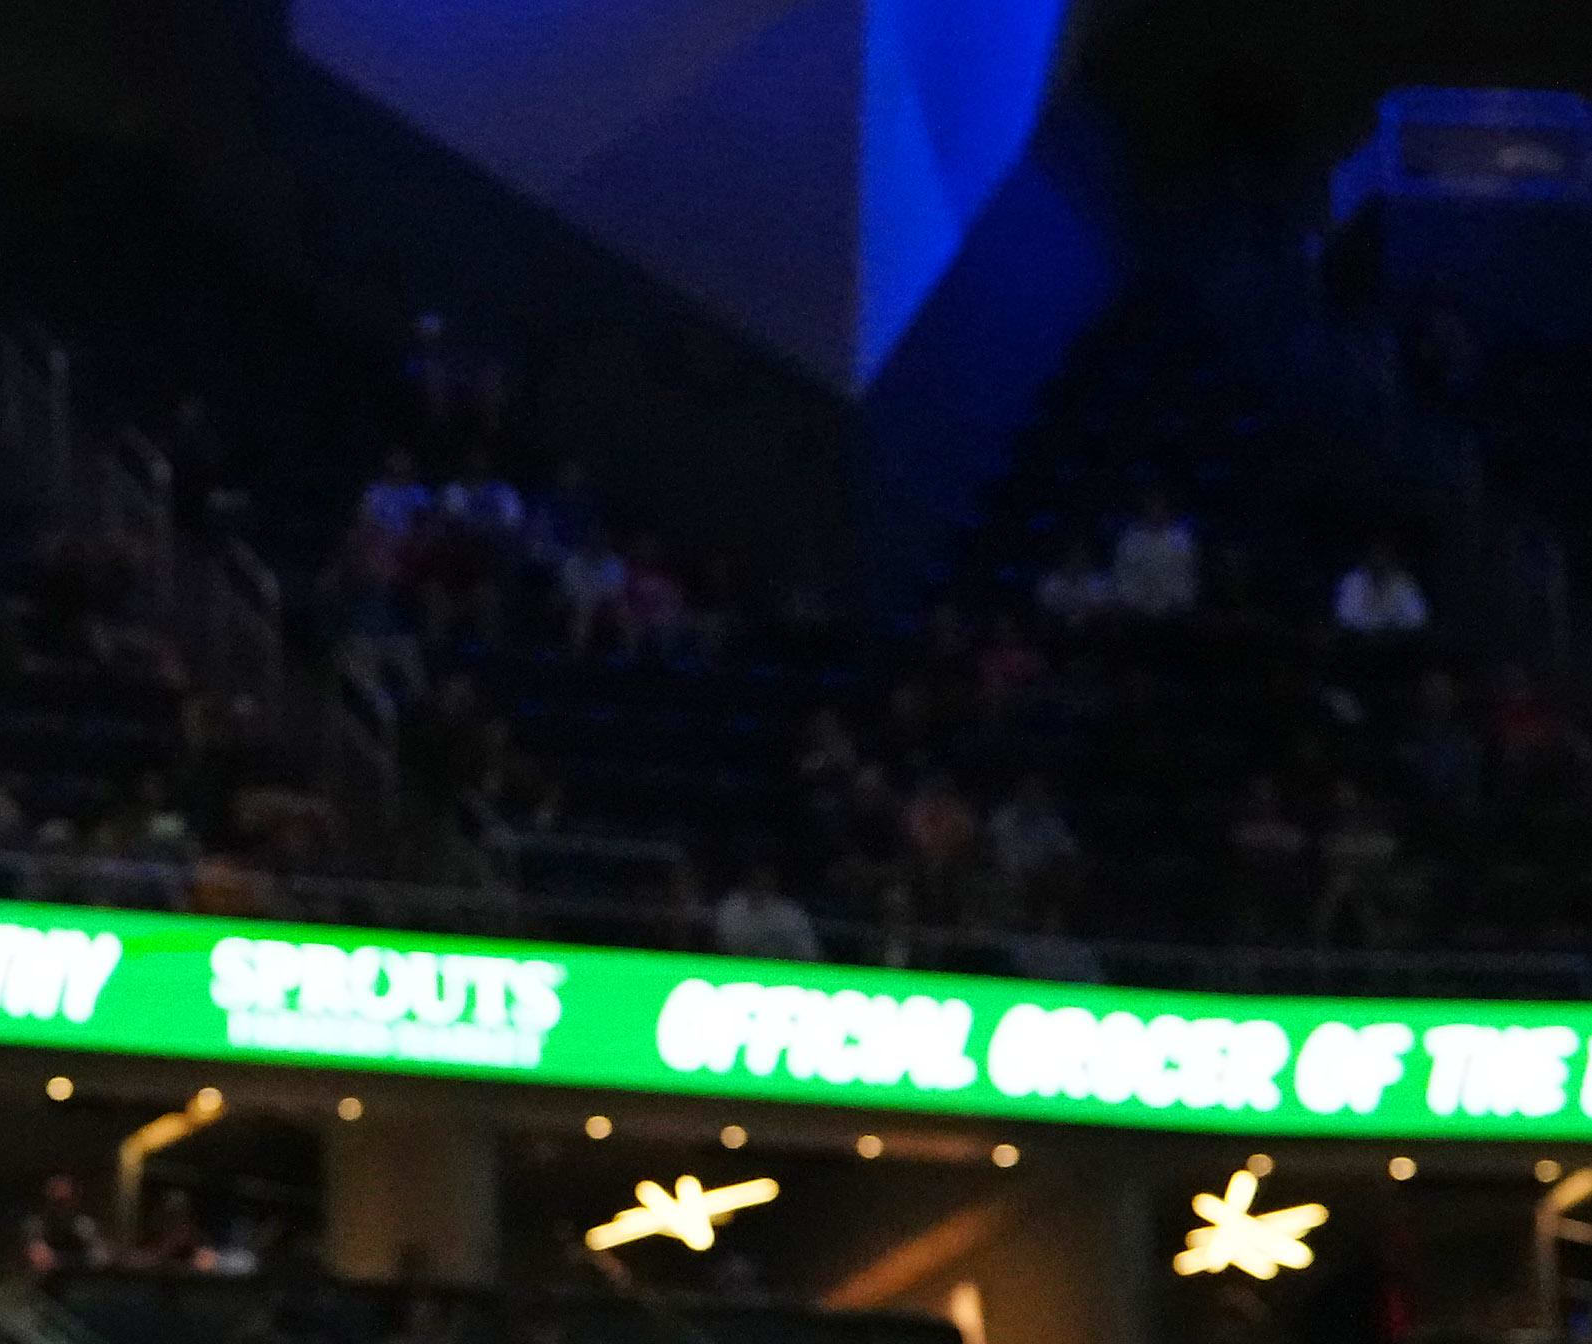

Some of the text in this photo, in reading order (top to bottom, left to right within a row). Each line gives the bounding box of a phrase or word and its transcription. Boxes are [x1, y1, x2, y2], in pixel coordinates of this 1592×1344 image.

[210, 937, 566, 1033] SPROUTS
[656, 978, 979, 1090] OFFICIAL
[987, 1003, 1291, 1112] GROCER
[1294, 1021, 1414, 1114] OF
[1423, 1023, 1579, 1117] THE
